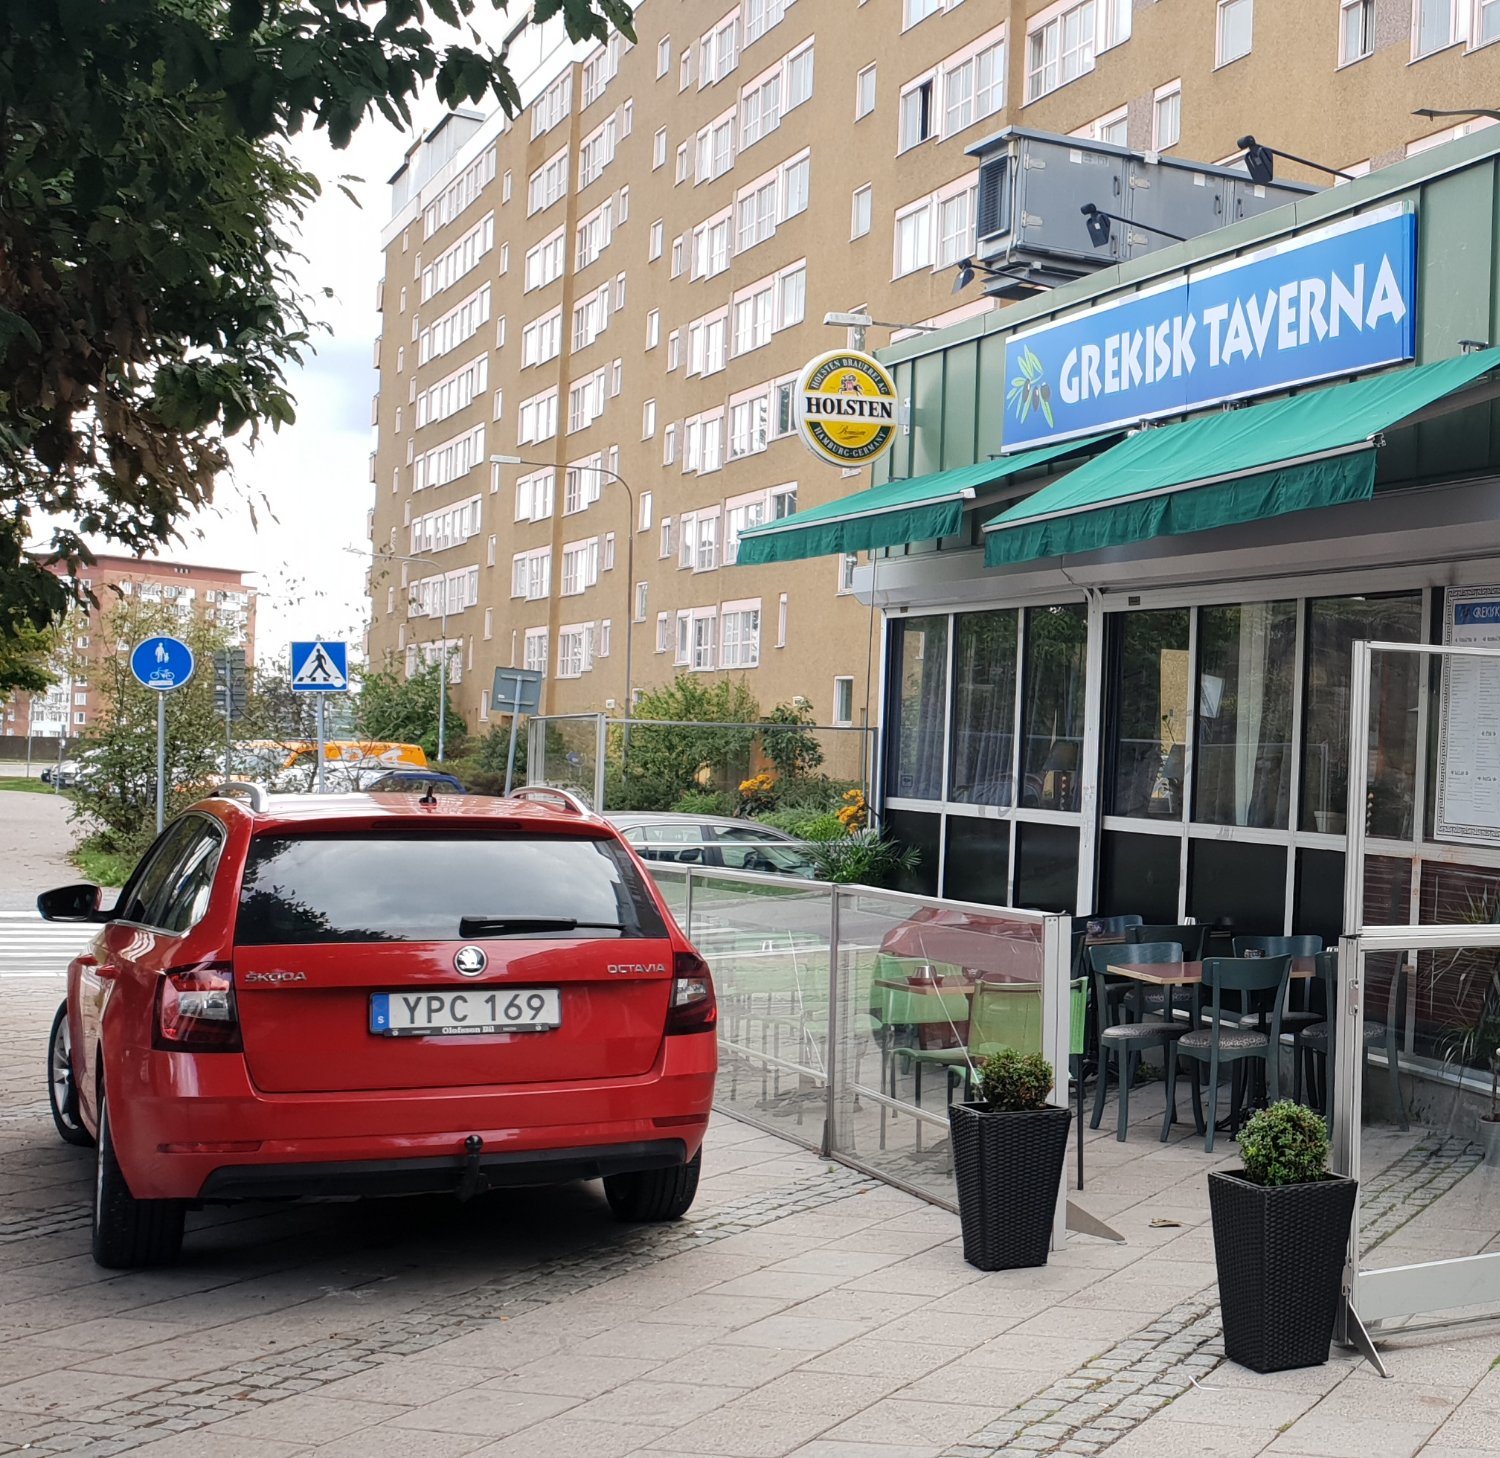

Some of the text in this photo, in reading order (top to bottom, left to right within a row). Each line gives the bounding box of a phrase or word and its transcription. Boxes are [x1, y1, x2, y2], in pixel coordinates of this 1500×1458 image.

[1059, 253, 1407, 404] GREKISK TAVERNA
[811, 358, 889, 394] HOLSTEN BRAUEREI AG
[805, 397, 893, 418] HOLSTEN
[1473, 606, 1500, 618] GREKISK
[245, 971, 307, 982] ŠKODA
[607, 964, 665, 973] OCTAVIA
[402, 994, 546, 1024] YPC 169
[377, 1016, 385, 1024] S
